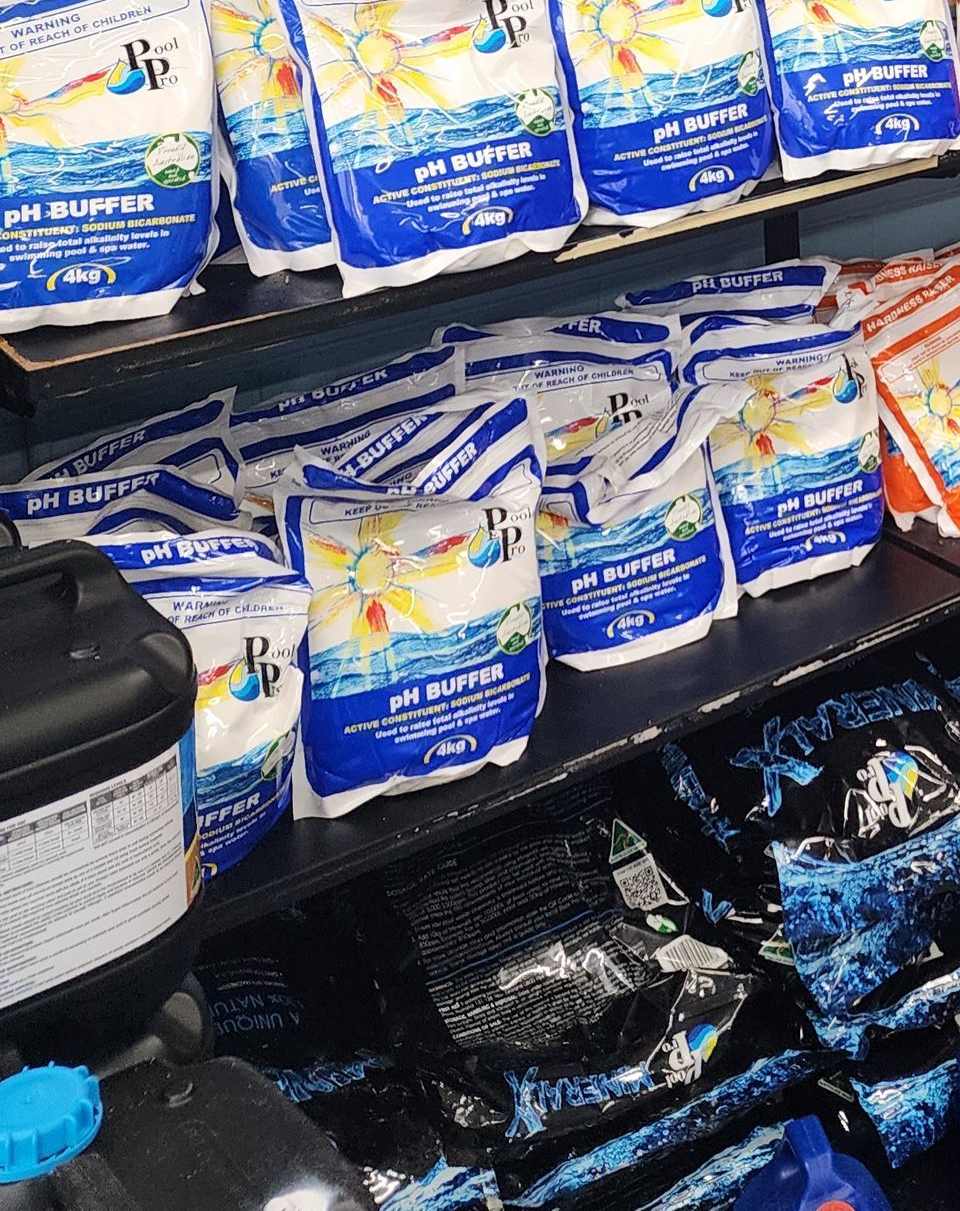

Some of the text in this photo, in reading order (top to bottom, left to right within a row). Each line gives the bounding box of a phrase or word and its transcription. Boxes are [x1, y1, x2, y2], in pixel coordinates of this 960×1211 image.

[10, 6, 152, 51] OF REACH OF CHILDREN
[11, 13, 81, 39] WARNING
[503, 17, 530, 50] Pro
[122, 38, 180, 71] Pool
[143, 56, 178, 93] Pro
[872, 64, 929, 81] BUFFER
[654, 102, 749, 144] pH BUFFER
[414, 140, 533, 184] pH BUFFER
[699, 169, 726, 185] 4kg
[4, 193, 155, 227] pH BUFFER
[82, 214, 196, 232] SODIUM BICARBONATE
[473, 210, 507, 227] 4kg
[84, 232, 129, 245] alkalinity
[62, 268, 101, 285] 4kg
[719, 271, 784, 289] BUFFER
[866, 294, 922, 334] HARDNESS
[534, 364, 586, 379] WARNING
[545, 376, 574, 388] REACH
[72, 429, 147, 474] BUFFER
[423, 441, 479, 494] BUFFER
[27, 493, 61, 515] pH
[777, 480, 863, 519] pH BUFFER
[482, 507, 533, 542] Pool
[141, 545, 173, 564] pH
[499, 525, 526, 563] Pro
[571, 548, 676, 594] pH BUFFER
[617, 615, 644, 629] 4kg
[389, 663, 504, 714] pH BUFFER
[344, 704, 448, 734] ACTIVE CONSTITUENT:
[436, 739, 466, 757] 4kg
